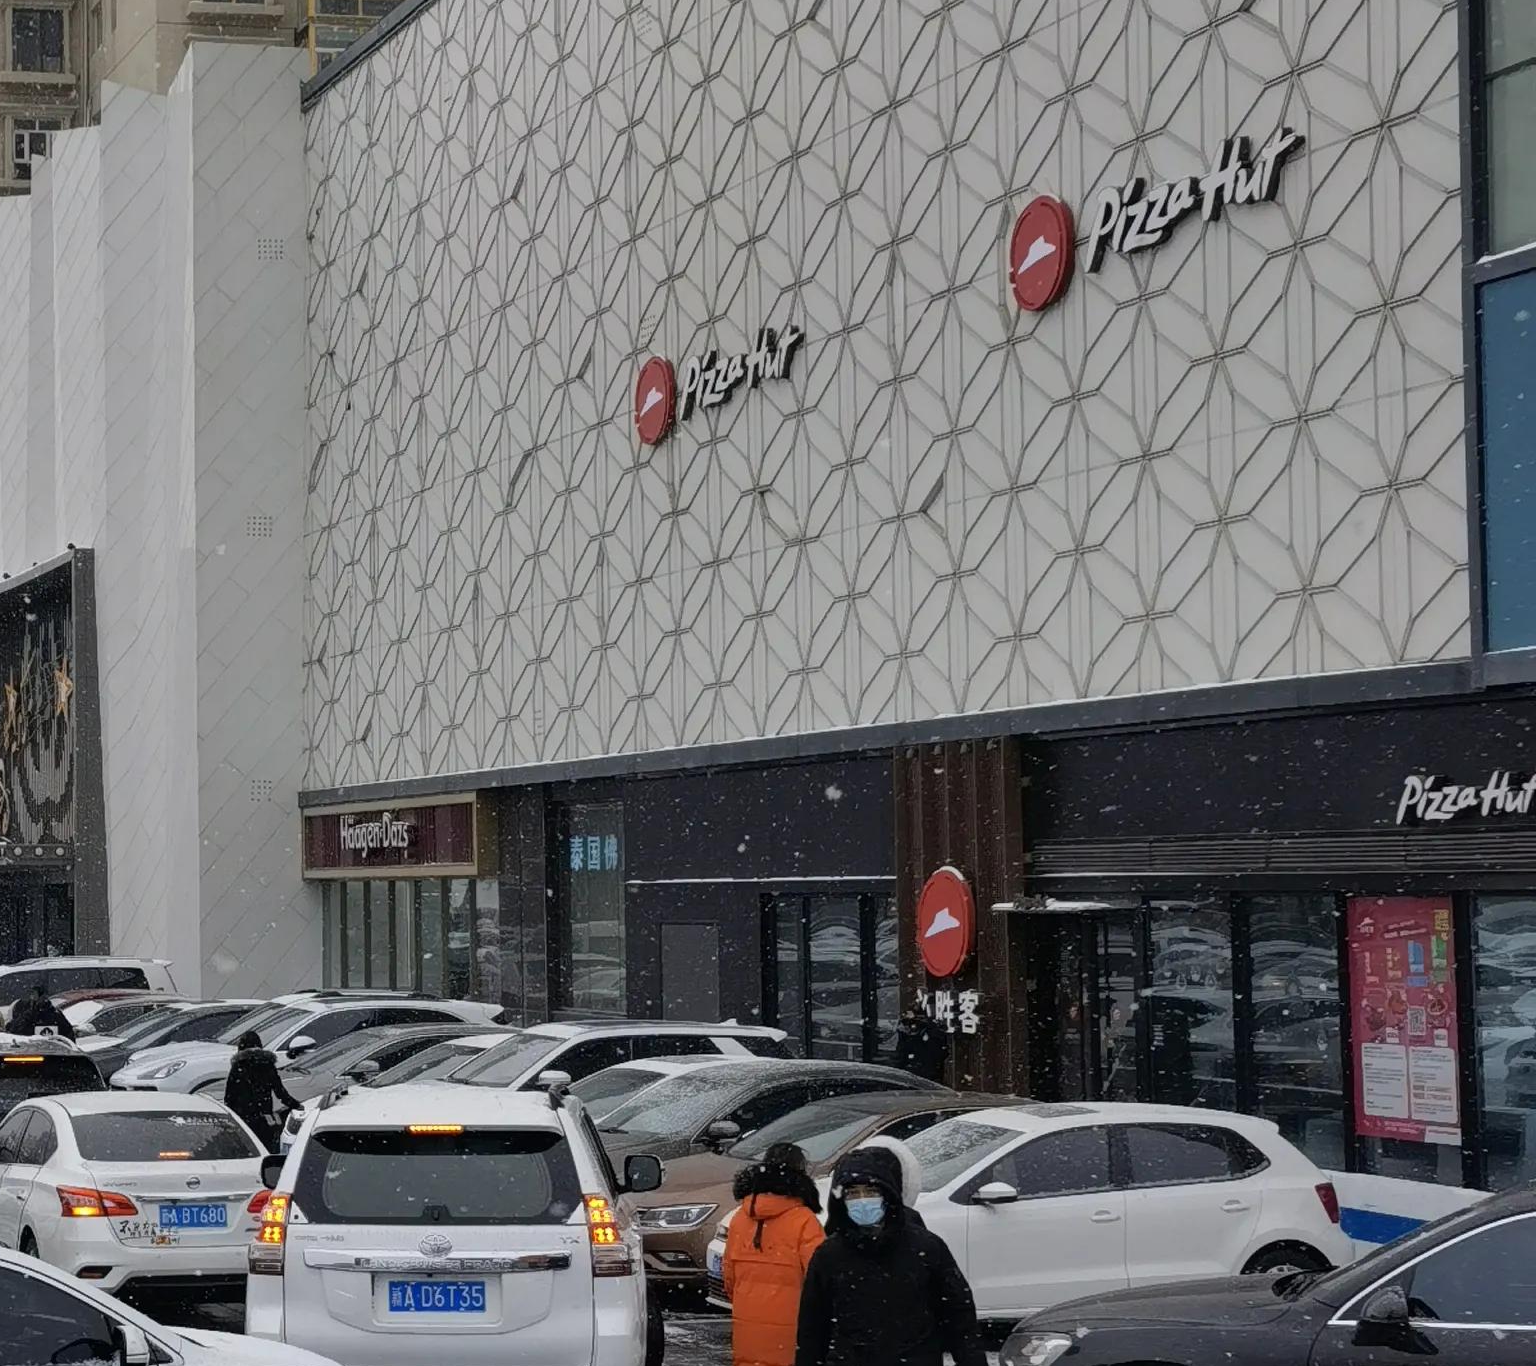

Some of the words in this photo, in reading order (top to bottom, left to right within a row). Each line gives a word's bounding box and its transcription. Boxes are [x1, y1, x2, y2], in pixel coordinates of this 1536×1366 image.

[1086, 178, 1194, 273] Pizza
[1199, 127, 1305, 221] Hut
[681, 350, 745, 420] Pizza
[746, 325, 804, 380] Hut
[1396, 775, 1479, 825] Pizza
[1480, 770, 1536, 817] Hut
